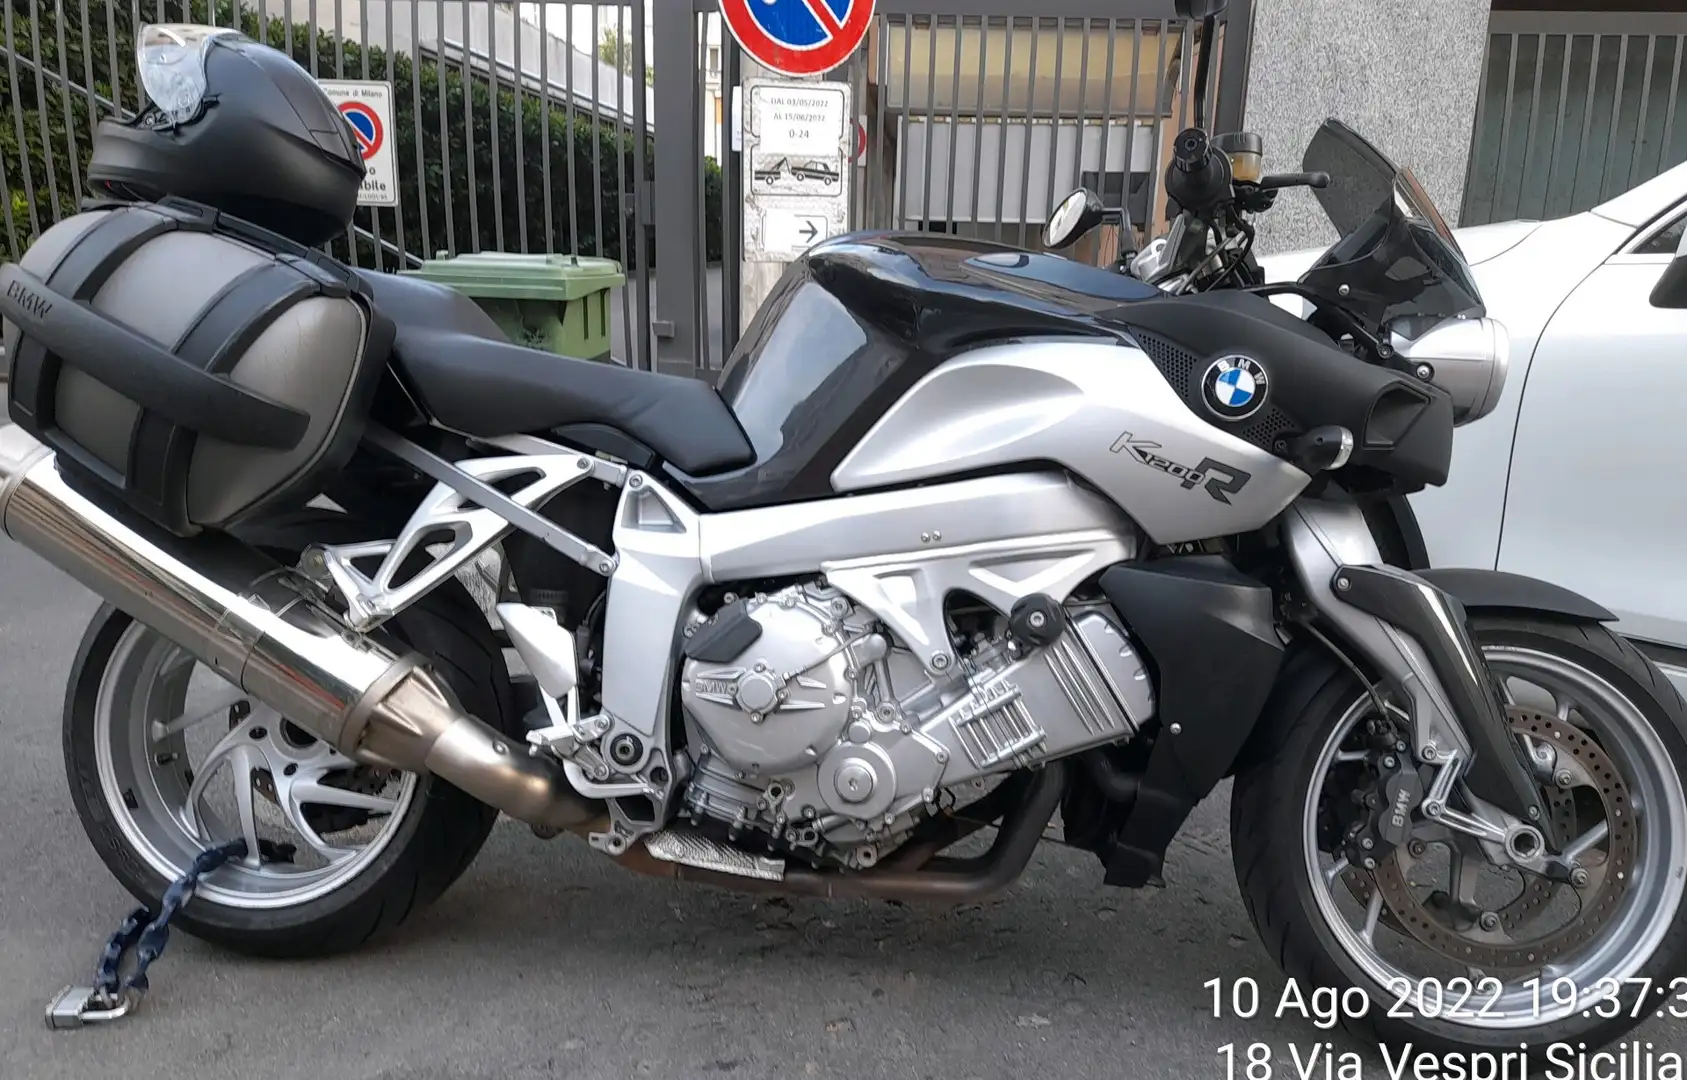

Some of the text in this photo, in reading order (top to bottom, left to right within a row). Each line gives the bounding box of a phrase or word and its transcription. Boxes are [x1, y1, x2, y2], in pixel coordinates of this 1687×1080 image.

[361, 89, 383, 98] Milano
[788, 128, 810, 139] 0-24
[7, 279, 52, 319] BMW
[1216, 357, 1266, 386] BMW
[1391, 788, 1411, 828] BMW
